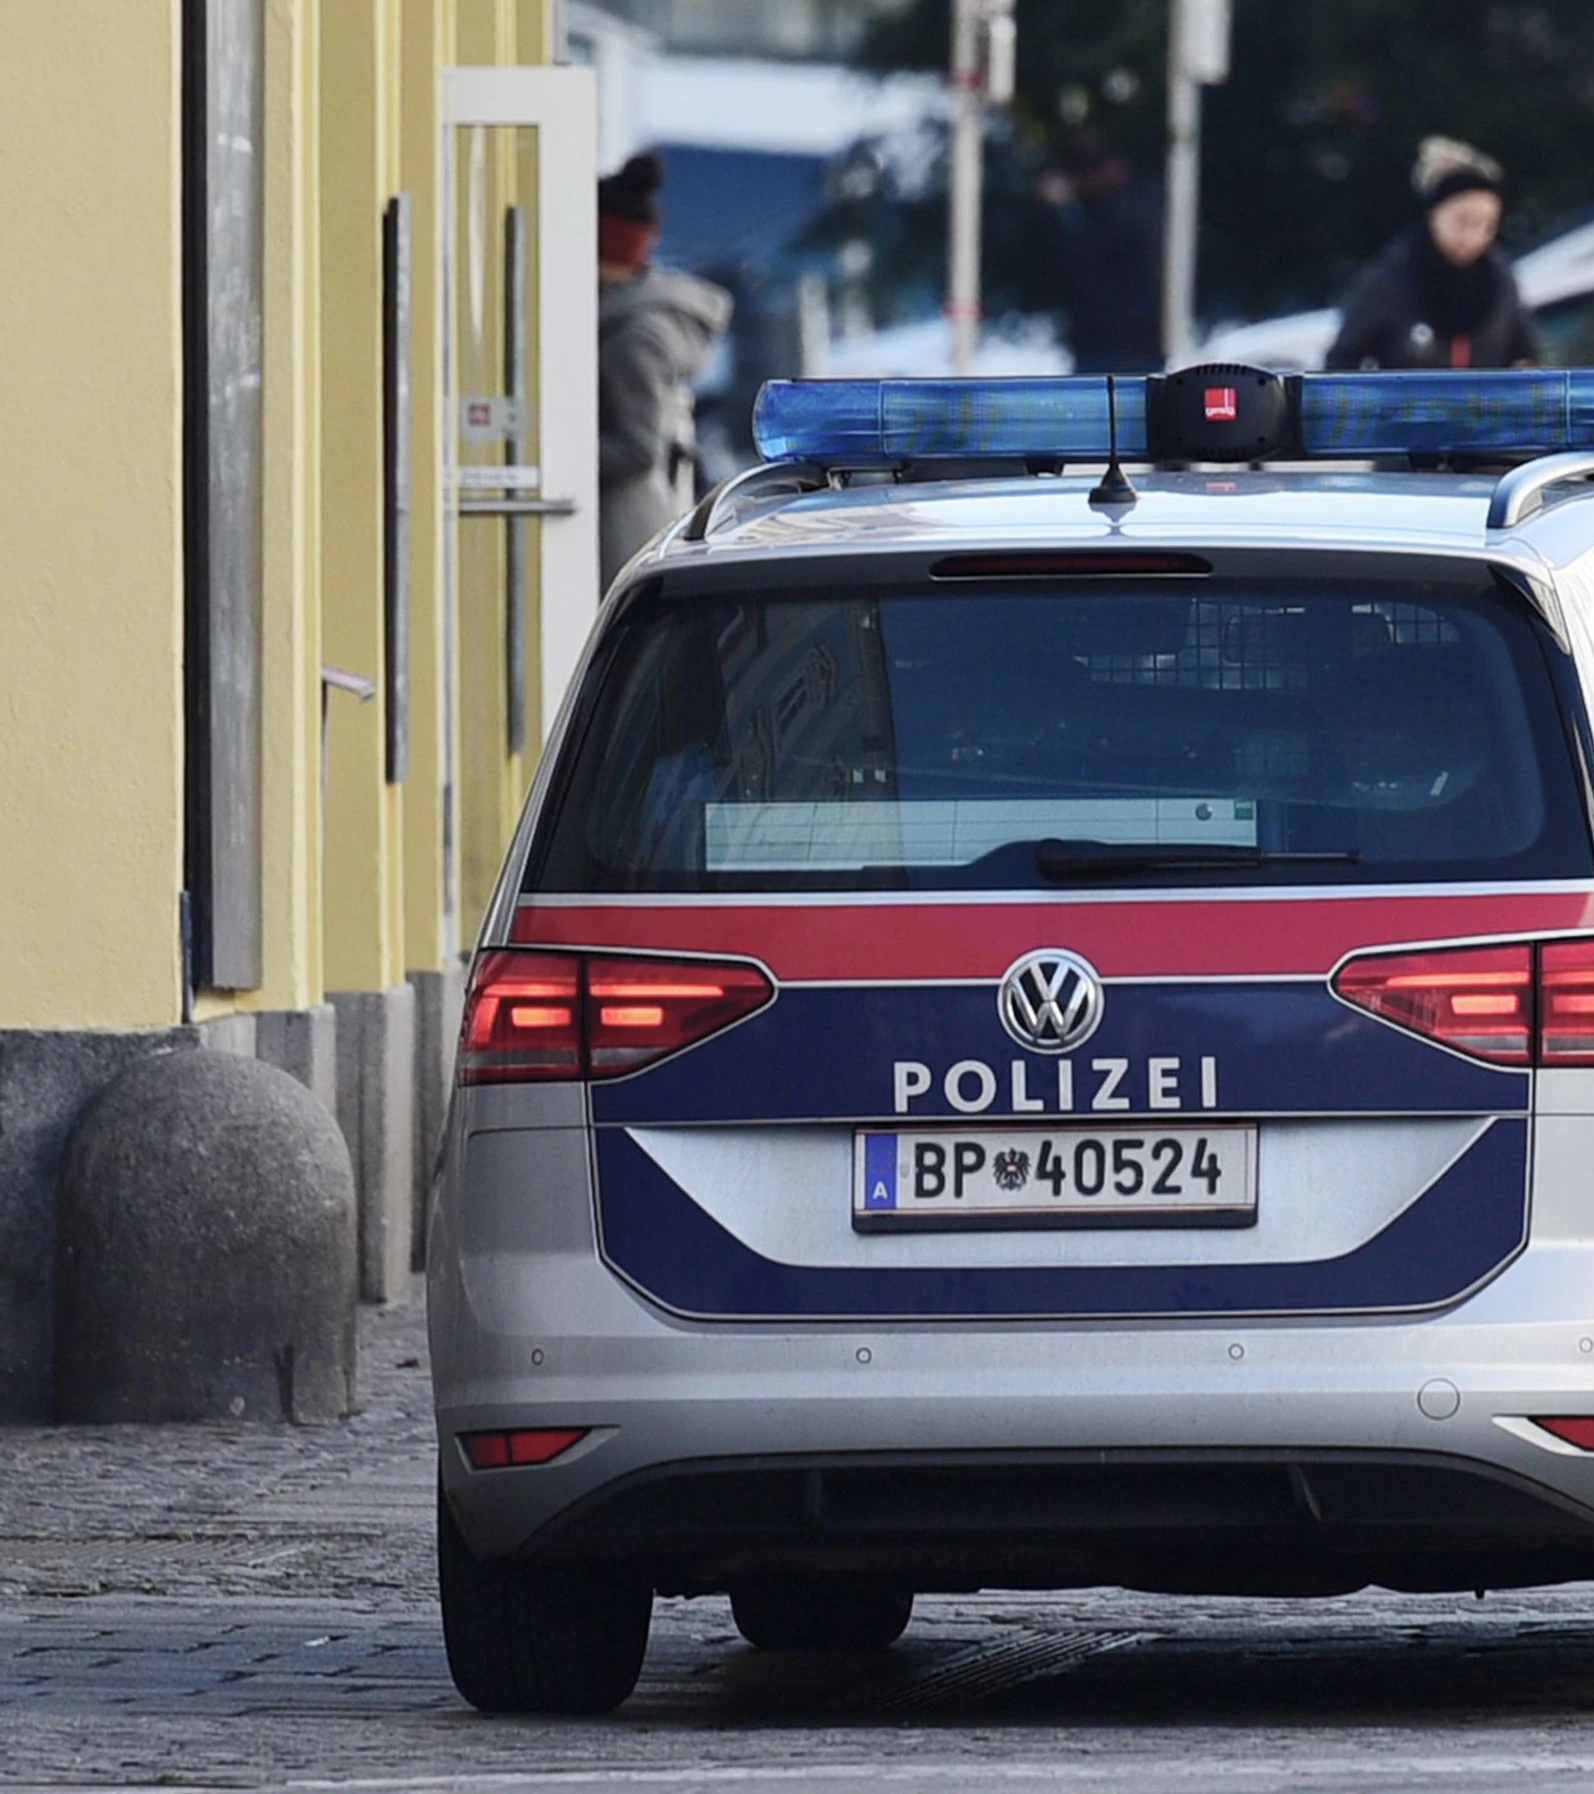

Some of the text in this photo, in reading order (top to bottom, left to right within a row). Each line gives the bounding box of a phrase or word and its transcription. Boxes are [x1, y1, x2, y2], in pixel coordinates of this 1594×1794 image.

[1005, 954, 1097, 1047] VW
[893, 1055, 1217, 1113] POLIZEI
[872, 1137, 1222, 1200] A BP 40524
